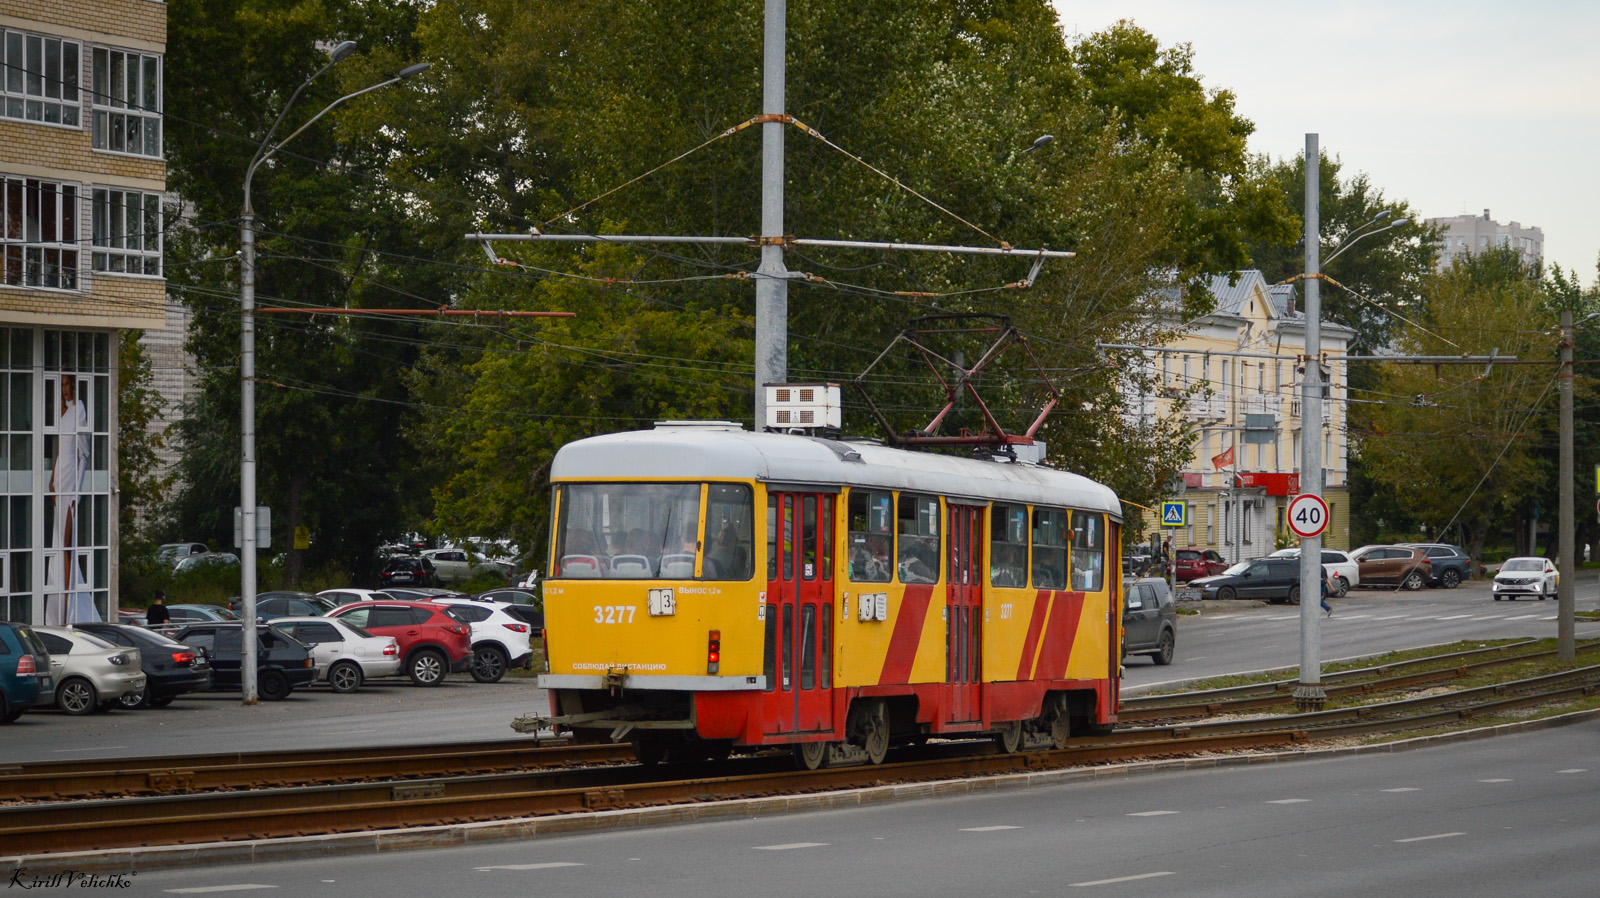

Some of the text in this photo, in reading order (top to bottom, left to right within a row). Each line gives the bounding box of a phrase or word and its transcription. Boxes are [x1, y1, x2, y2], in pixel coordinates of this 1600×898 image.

[1296, 507, 1320, 524] 40
[678, 586, 707, 595] ВЫНОС
[663, 594, 671, 608] 3
[593, 605, 637, 624] 3277
[1000, 603, 1013, 620] 3277
[572, 661, 667, 671] СОБЛЮДАЙ ДИСТАНЦИЮ
